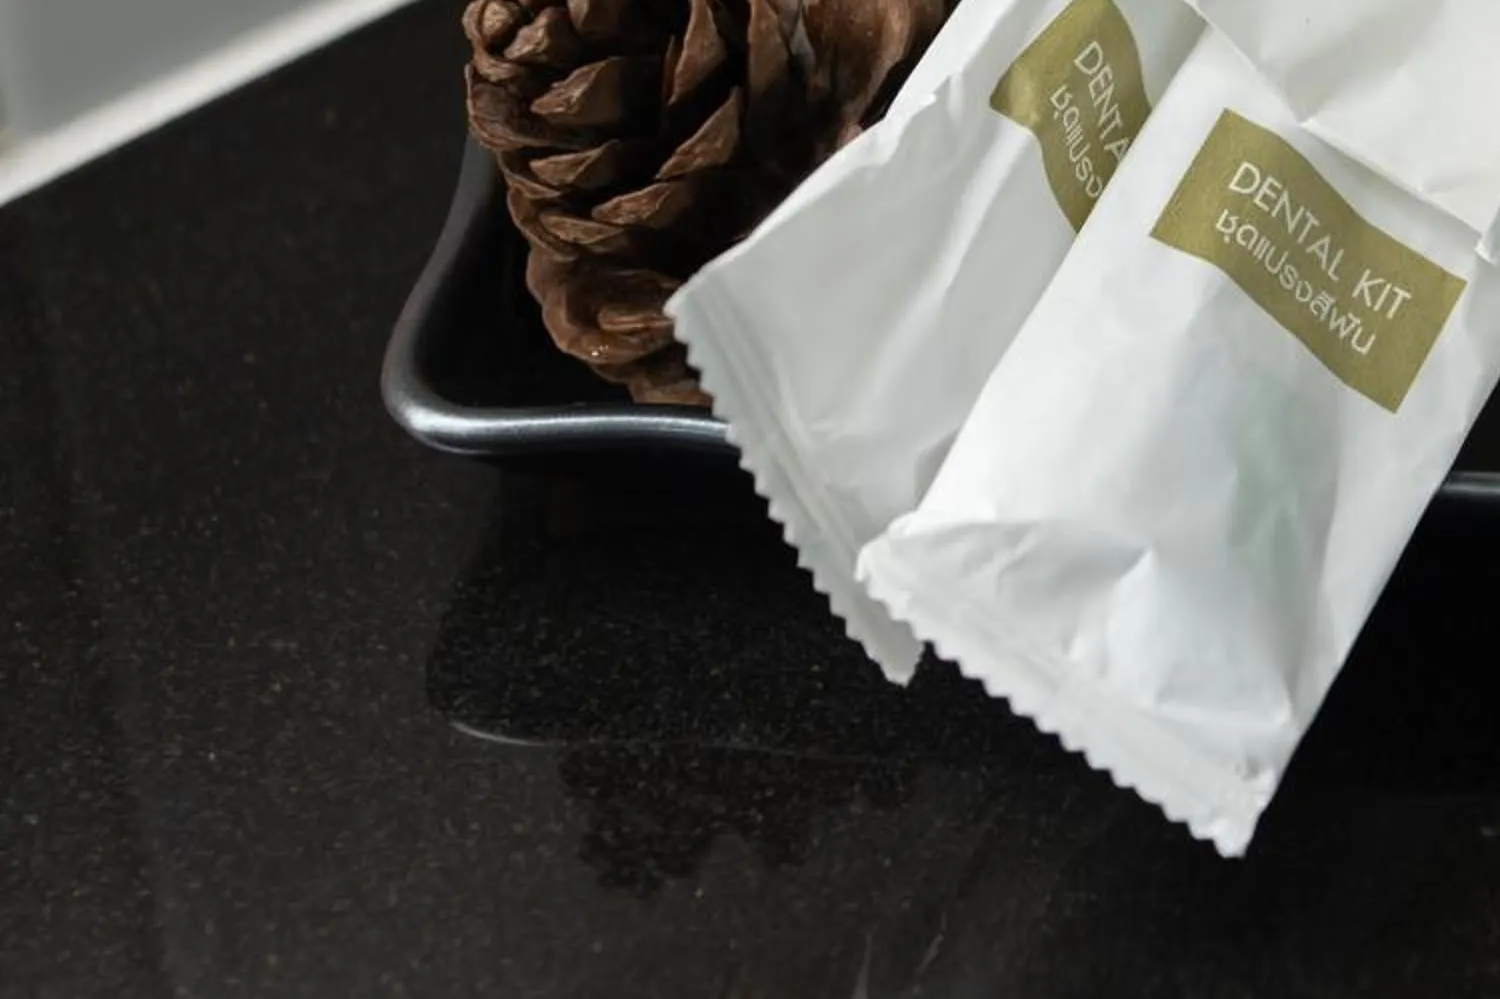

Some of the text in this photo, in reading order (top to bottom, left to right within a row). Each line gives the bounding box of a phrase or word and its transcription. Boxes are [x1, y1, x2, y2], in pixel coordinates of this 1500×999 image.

[1073, 40, 1130, 163] DENTA
[1215, 208, 1376, 356] ชุดแปรงสีฟัน
[1228, 161, 1412, 320] DENTAL KIT
